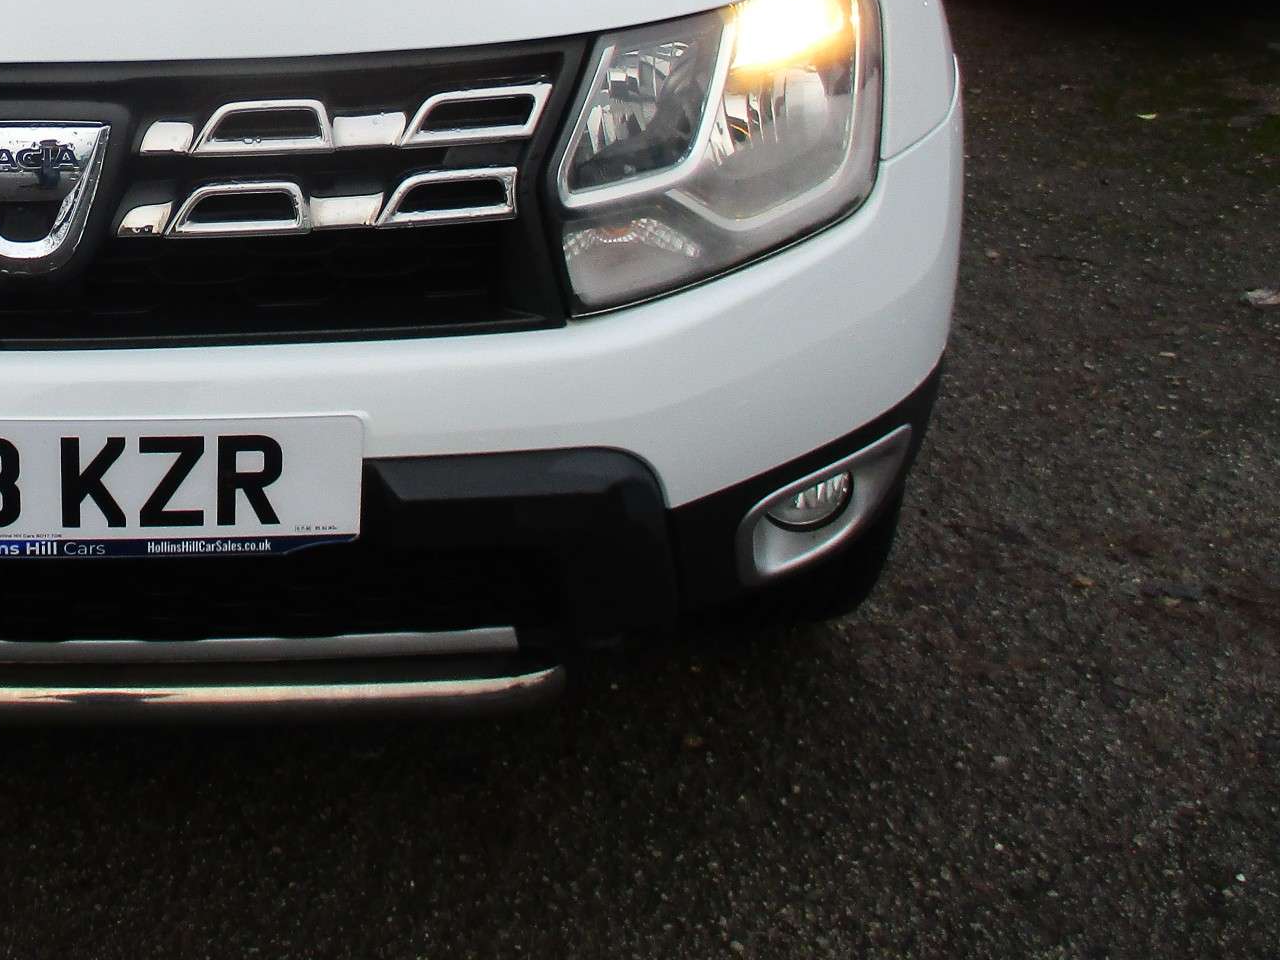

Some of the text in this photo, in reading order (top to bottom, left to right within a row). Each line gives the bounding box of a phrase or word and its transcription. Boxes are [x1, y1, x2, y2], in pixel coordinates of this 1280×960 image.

[60, 435, 283, 528] KZR
[26, 542, 57, 555] Hill
[63, 542, 106, 555] Cars
[147, 540, 271, 553] HollinsHillCarSales.co.uk
